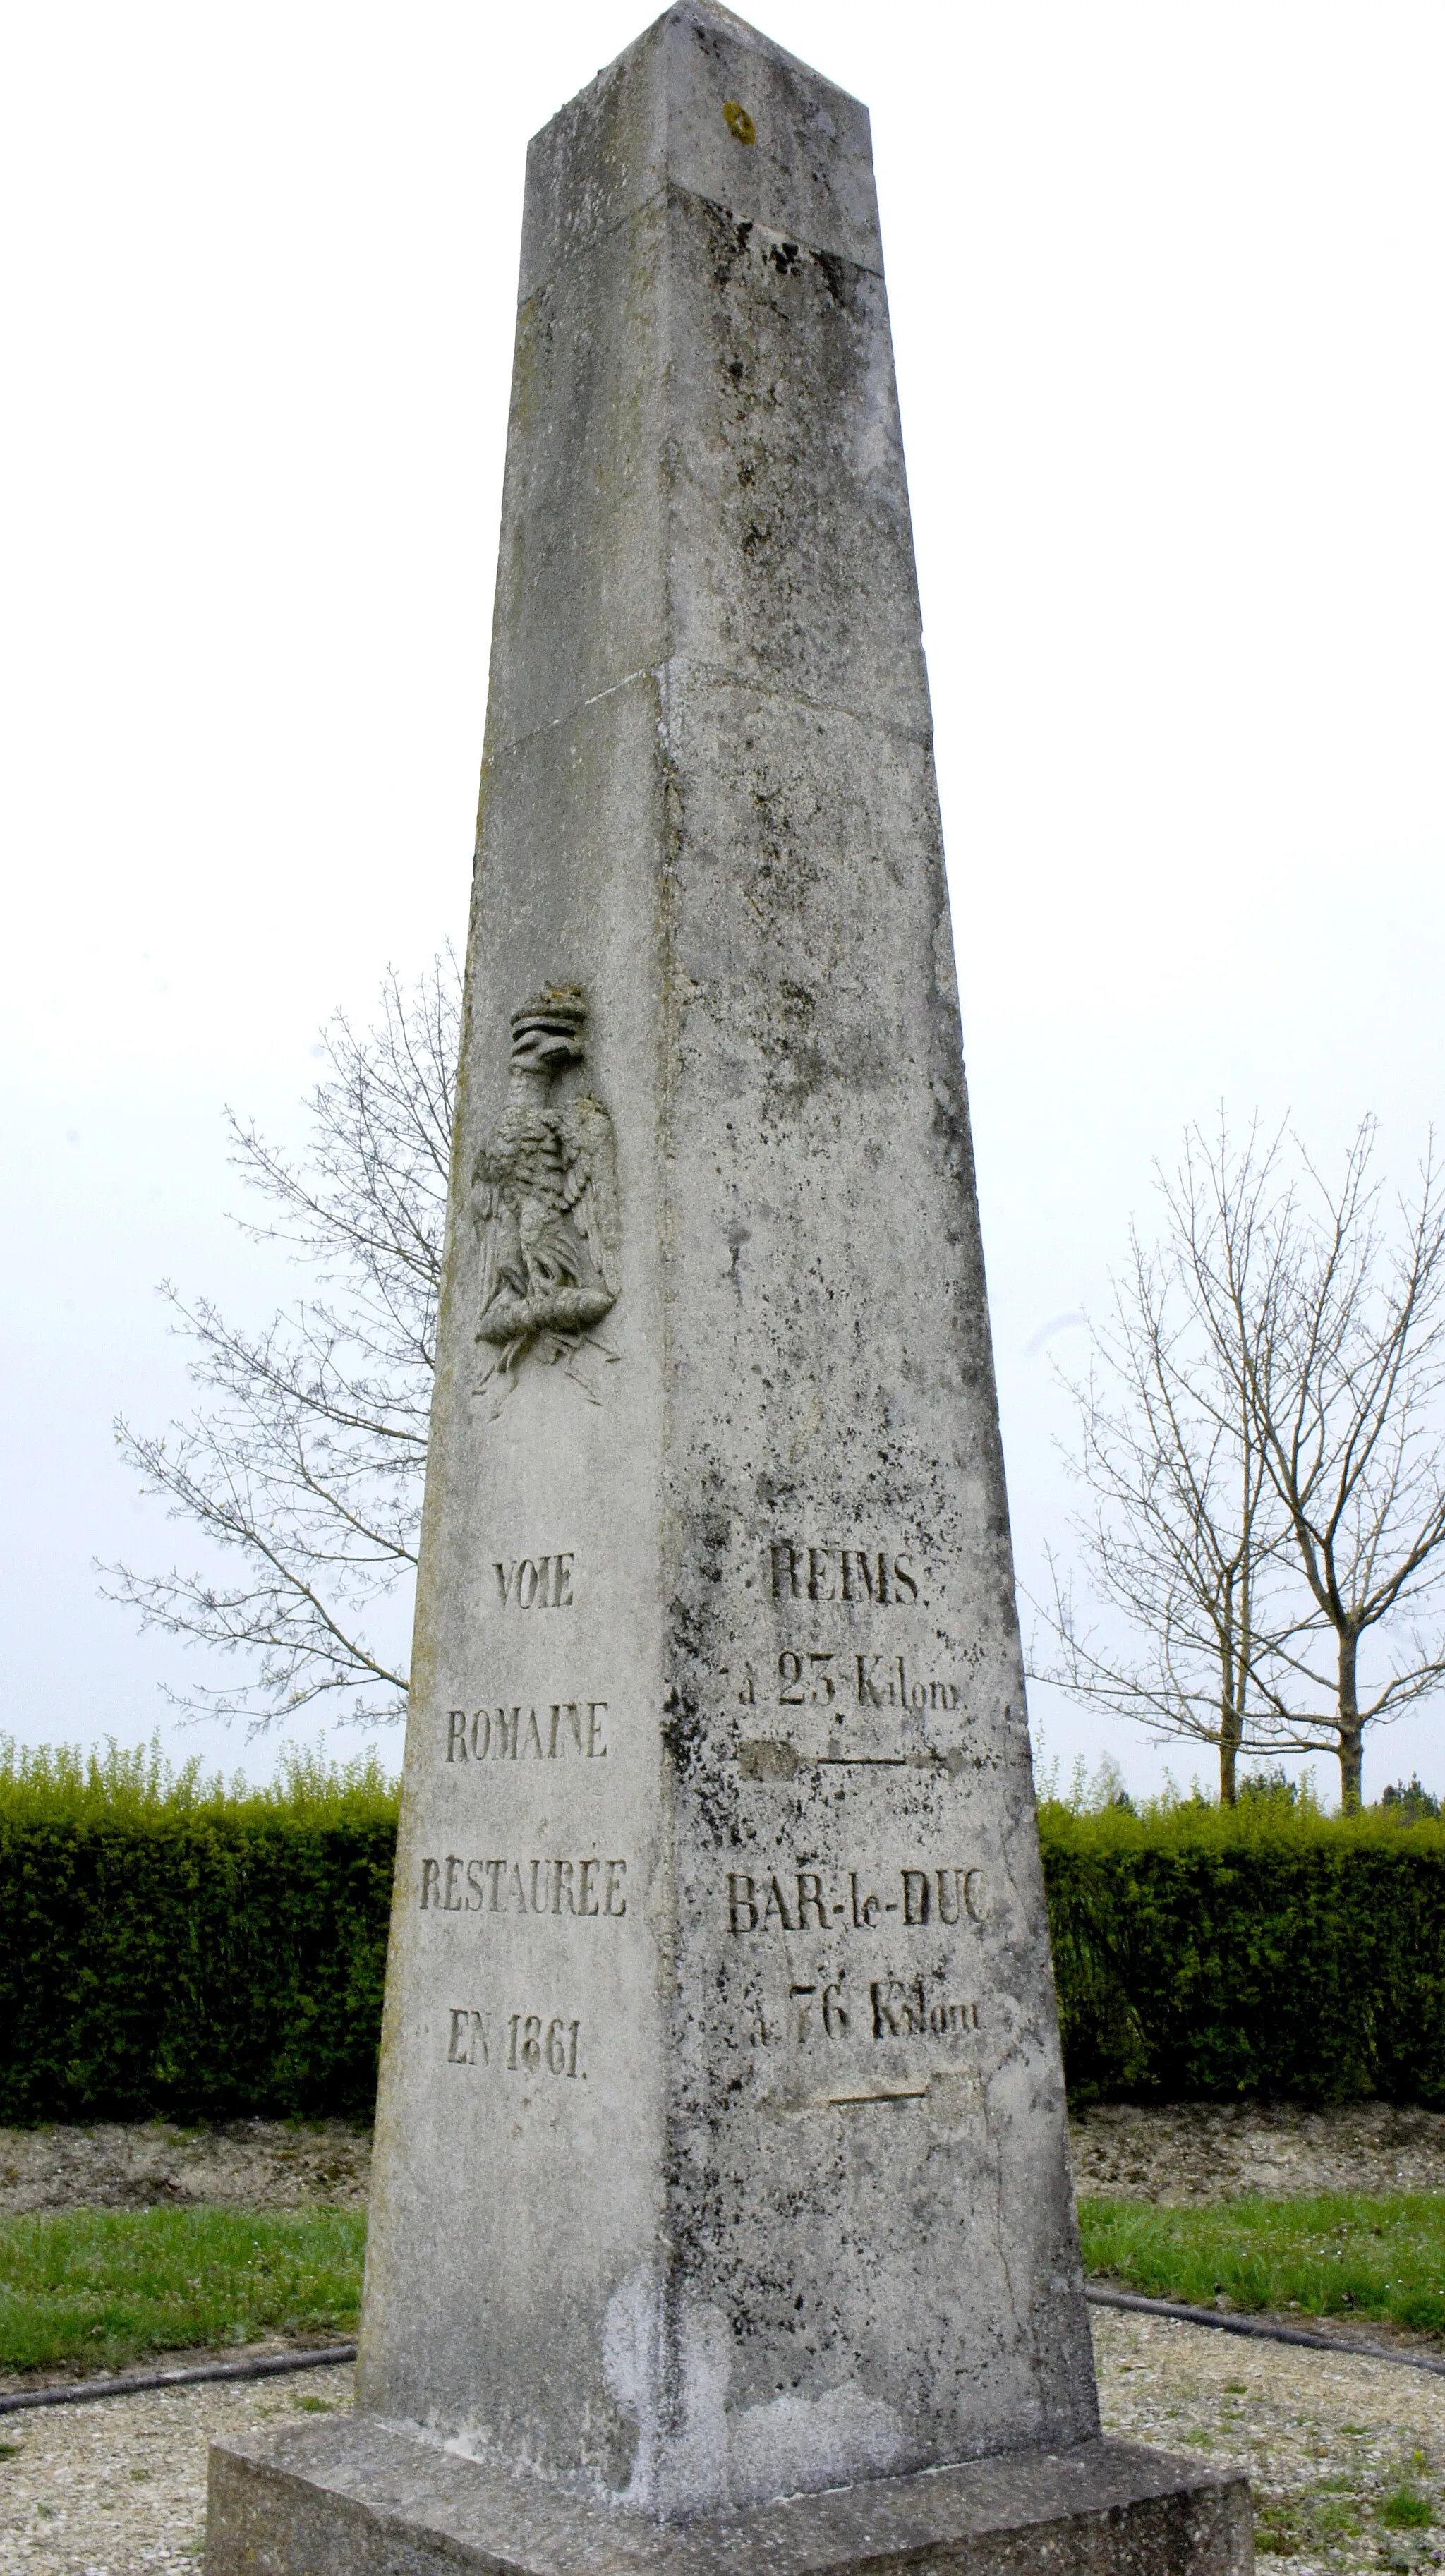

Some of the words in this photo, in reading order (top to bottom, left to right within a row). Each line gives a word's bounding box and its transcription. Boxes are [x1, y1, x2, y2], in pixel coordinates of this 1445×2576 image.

[492, 1552, 574, 1610] VOIE
[768, 1539, 919, 1606] REIMS
[445, 1702, 608, 1762] ROMAINE
[447, 2007, 492, 2065] EN
